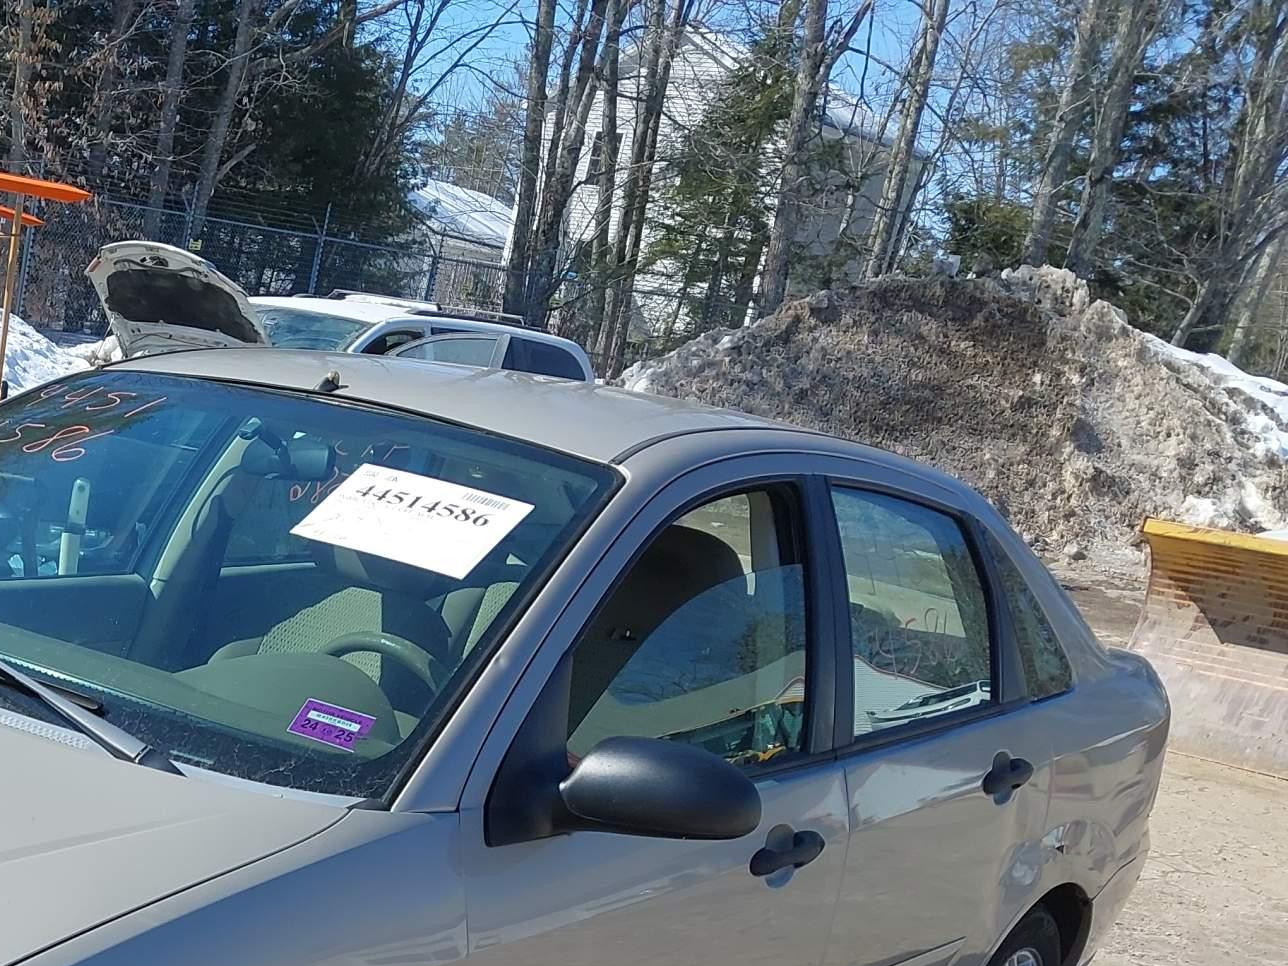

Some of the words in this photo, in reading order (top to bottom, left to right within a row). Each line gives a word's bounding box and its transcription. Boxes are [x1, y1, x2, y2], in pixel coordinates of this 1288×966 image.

[25, 384, 167, 418] 4451
[355, 484, 495, 527] 44514586
[300, 718, 319, 731] 24
[334, 729, 355, 743] 25
